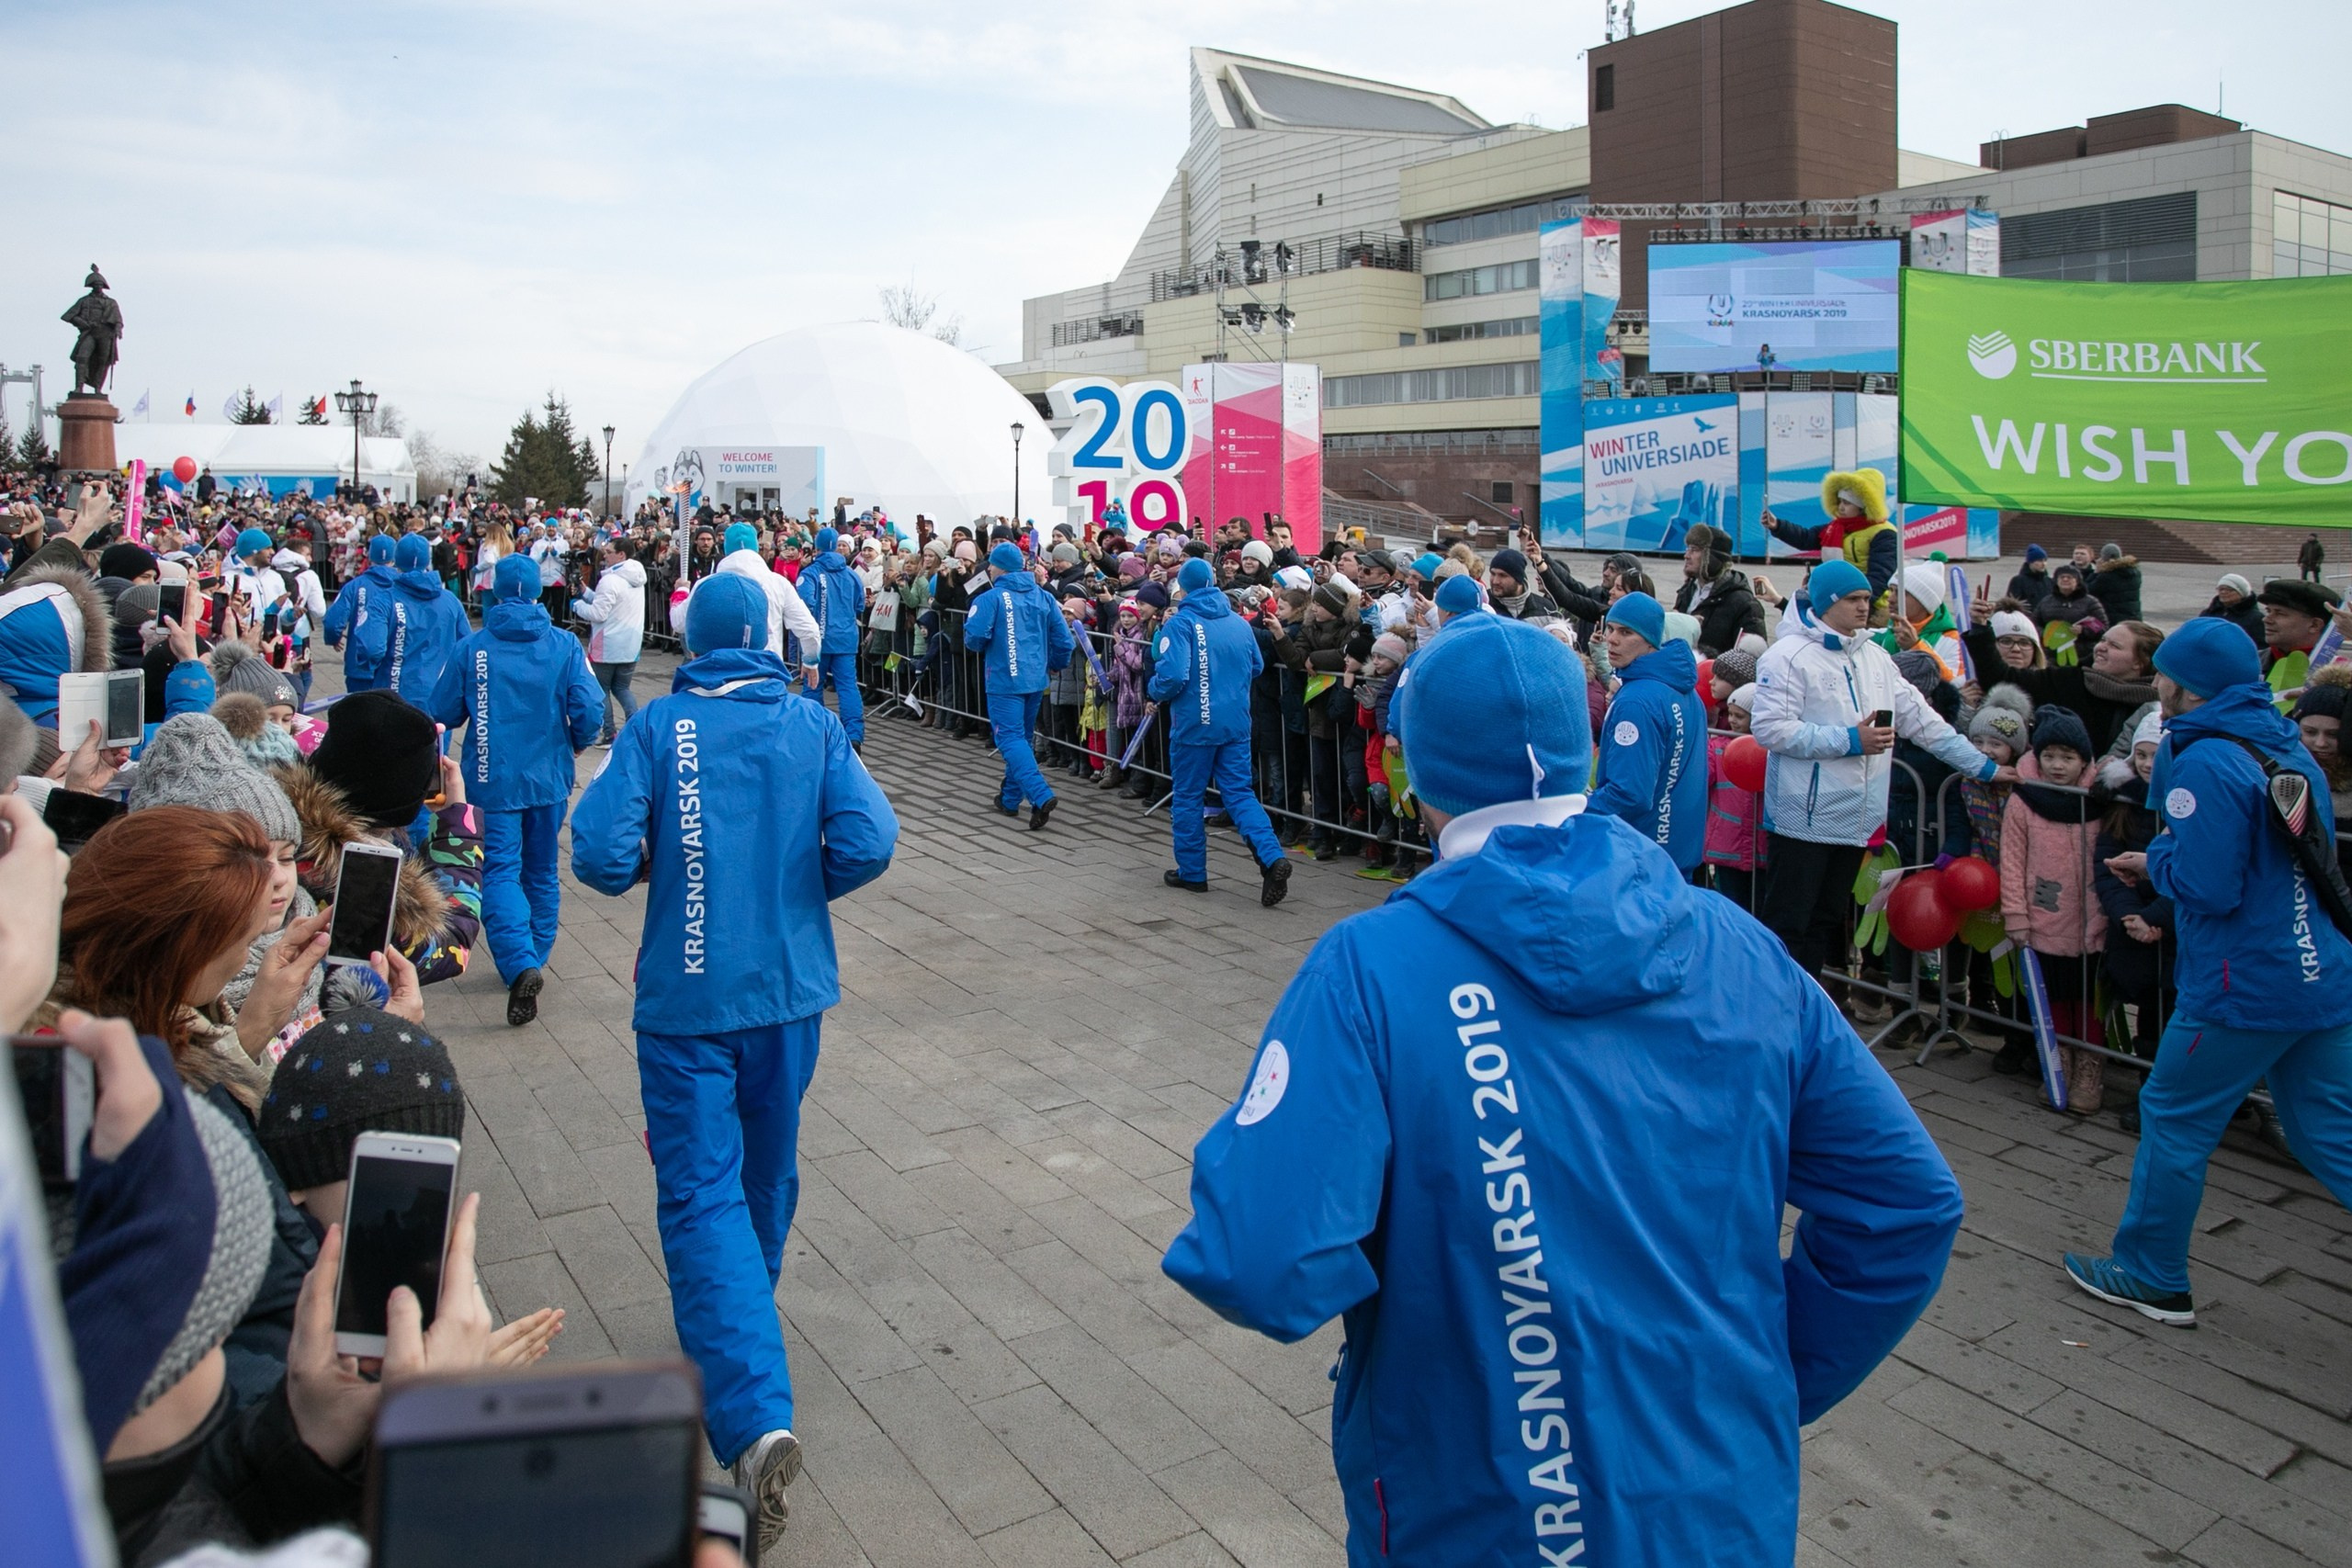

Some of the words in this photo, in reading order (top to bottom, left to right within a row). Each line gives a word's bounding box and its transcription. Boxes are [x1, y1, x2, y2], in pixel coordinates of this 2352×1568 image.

[1742, 309, 1821, 318] KRASNOYARSK
[1824, 308, 1847, 318] 2019
[2029, 338, 2267, 374] SBERBANK
[722, 453, 774, 462] WELCOME
[1589, 431, 1660, 459] WINTER
[1601, 436, 1731, 477] UNIVERSIADE
[1971, 414, 2190, 486] WISH
[2215, 430, 2352, 486] YO
[718, 464, 732, 473] TO
[735, 464, 777, 473] WINTER!
[1904, 514, 1957, 540] NOYARSK2019
[358, 587, 367, 606] 2019
[395, 602, 406, 625] 2019
[1002, 592, 1013, 610] 2019
[1007, 611, 1017, 677] KRASNOYARSK
[1195, 624, 1206, 647] 2019
[390, 625, 407, 694] RASNOYARSK
[476, 650, 488, 680] 2019
[1199, 649, 1210, 725] KRASNOYARSK
[476, 682, 489, 783] KRASNOYARSK
[675, 718, 699, 773] 2019
[678, 777, 706, 974] KRASNOYARSK
[2292, 856, 2321, 983] KRASNOYA
[1450, 983, 1520, 1121] 2019
[1477, 1127, 1588, 1568] KRASNOYARSK
